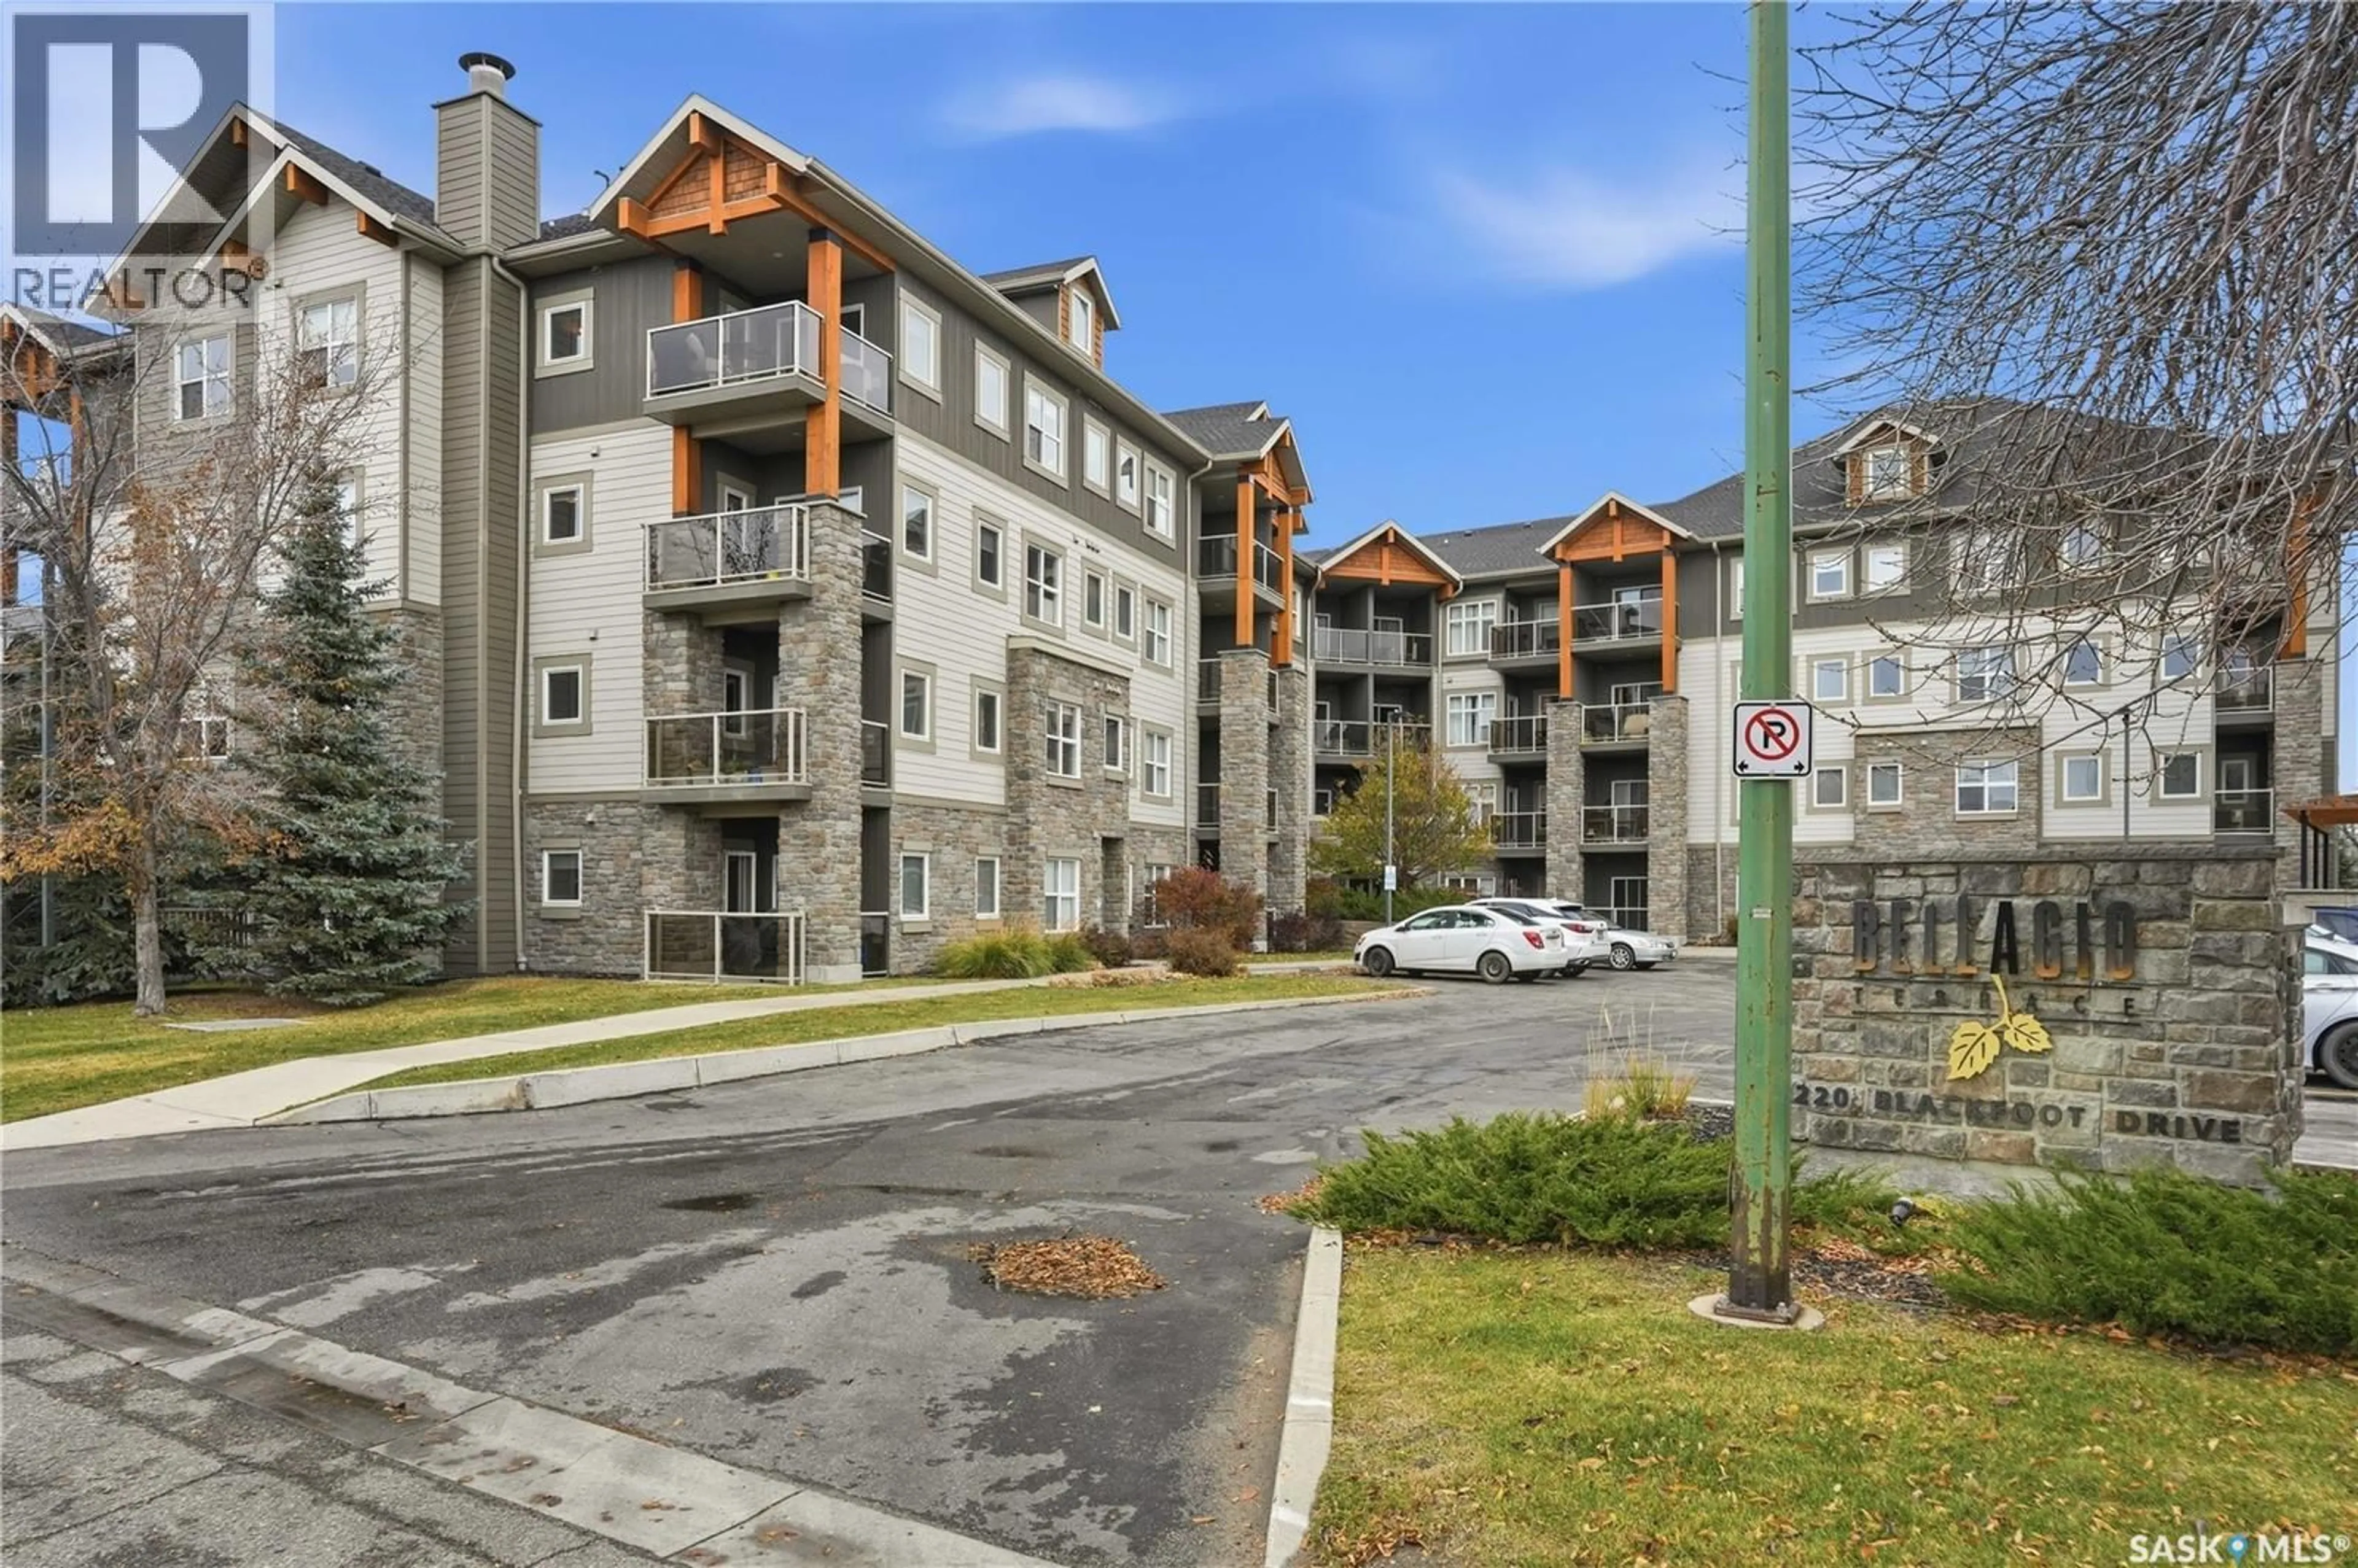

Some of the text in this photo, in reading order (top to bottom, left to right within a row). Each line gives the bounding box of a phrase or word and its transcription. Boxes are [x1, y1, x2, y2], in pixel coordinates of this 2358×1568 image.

[1763, 721, 1787, 749] P
[1853, 896, 2136, 980] BELLAGIO
[1854, 986, 2136, 1015] TERRACE
[1794, 1084, 2241, 1143] 220 BLACKFOOT DRIVE
